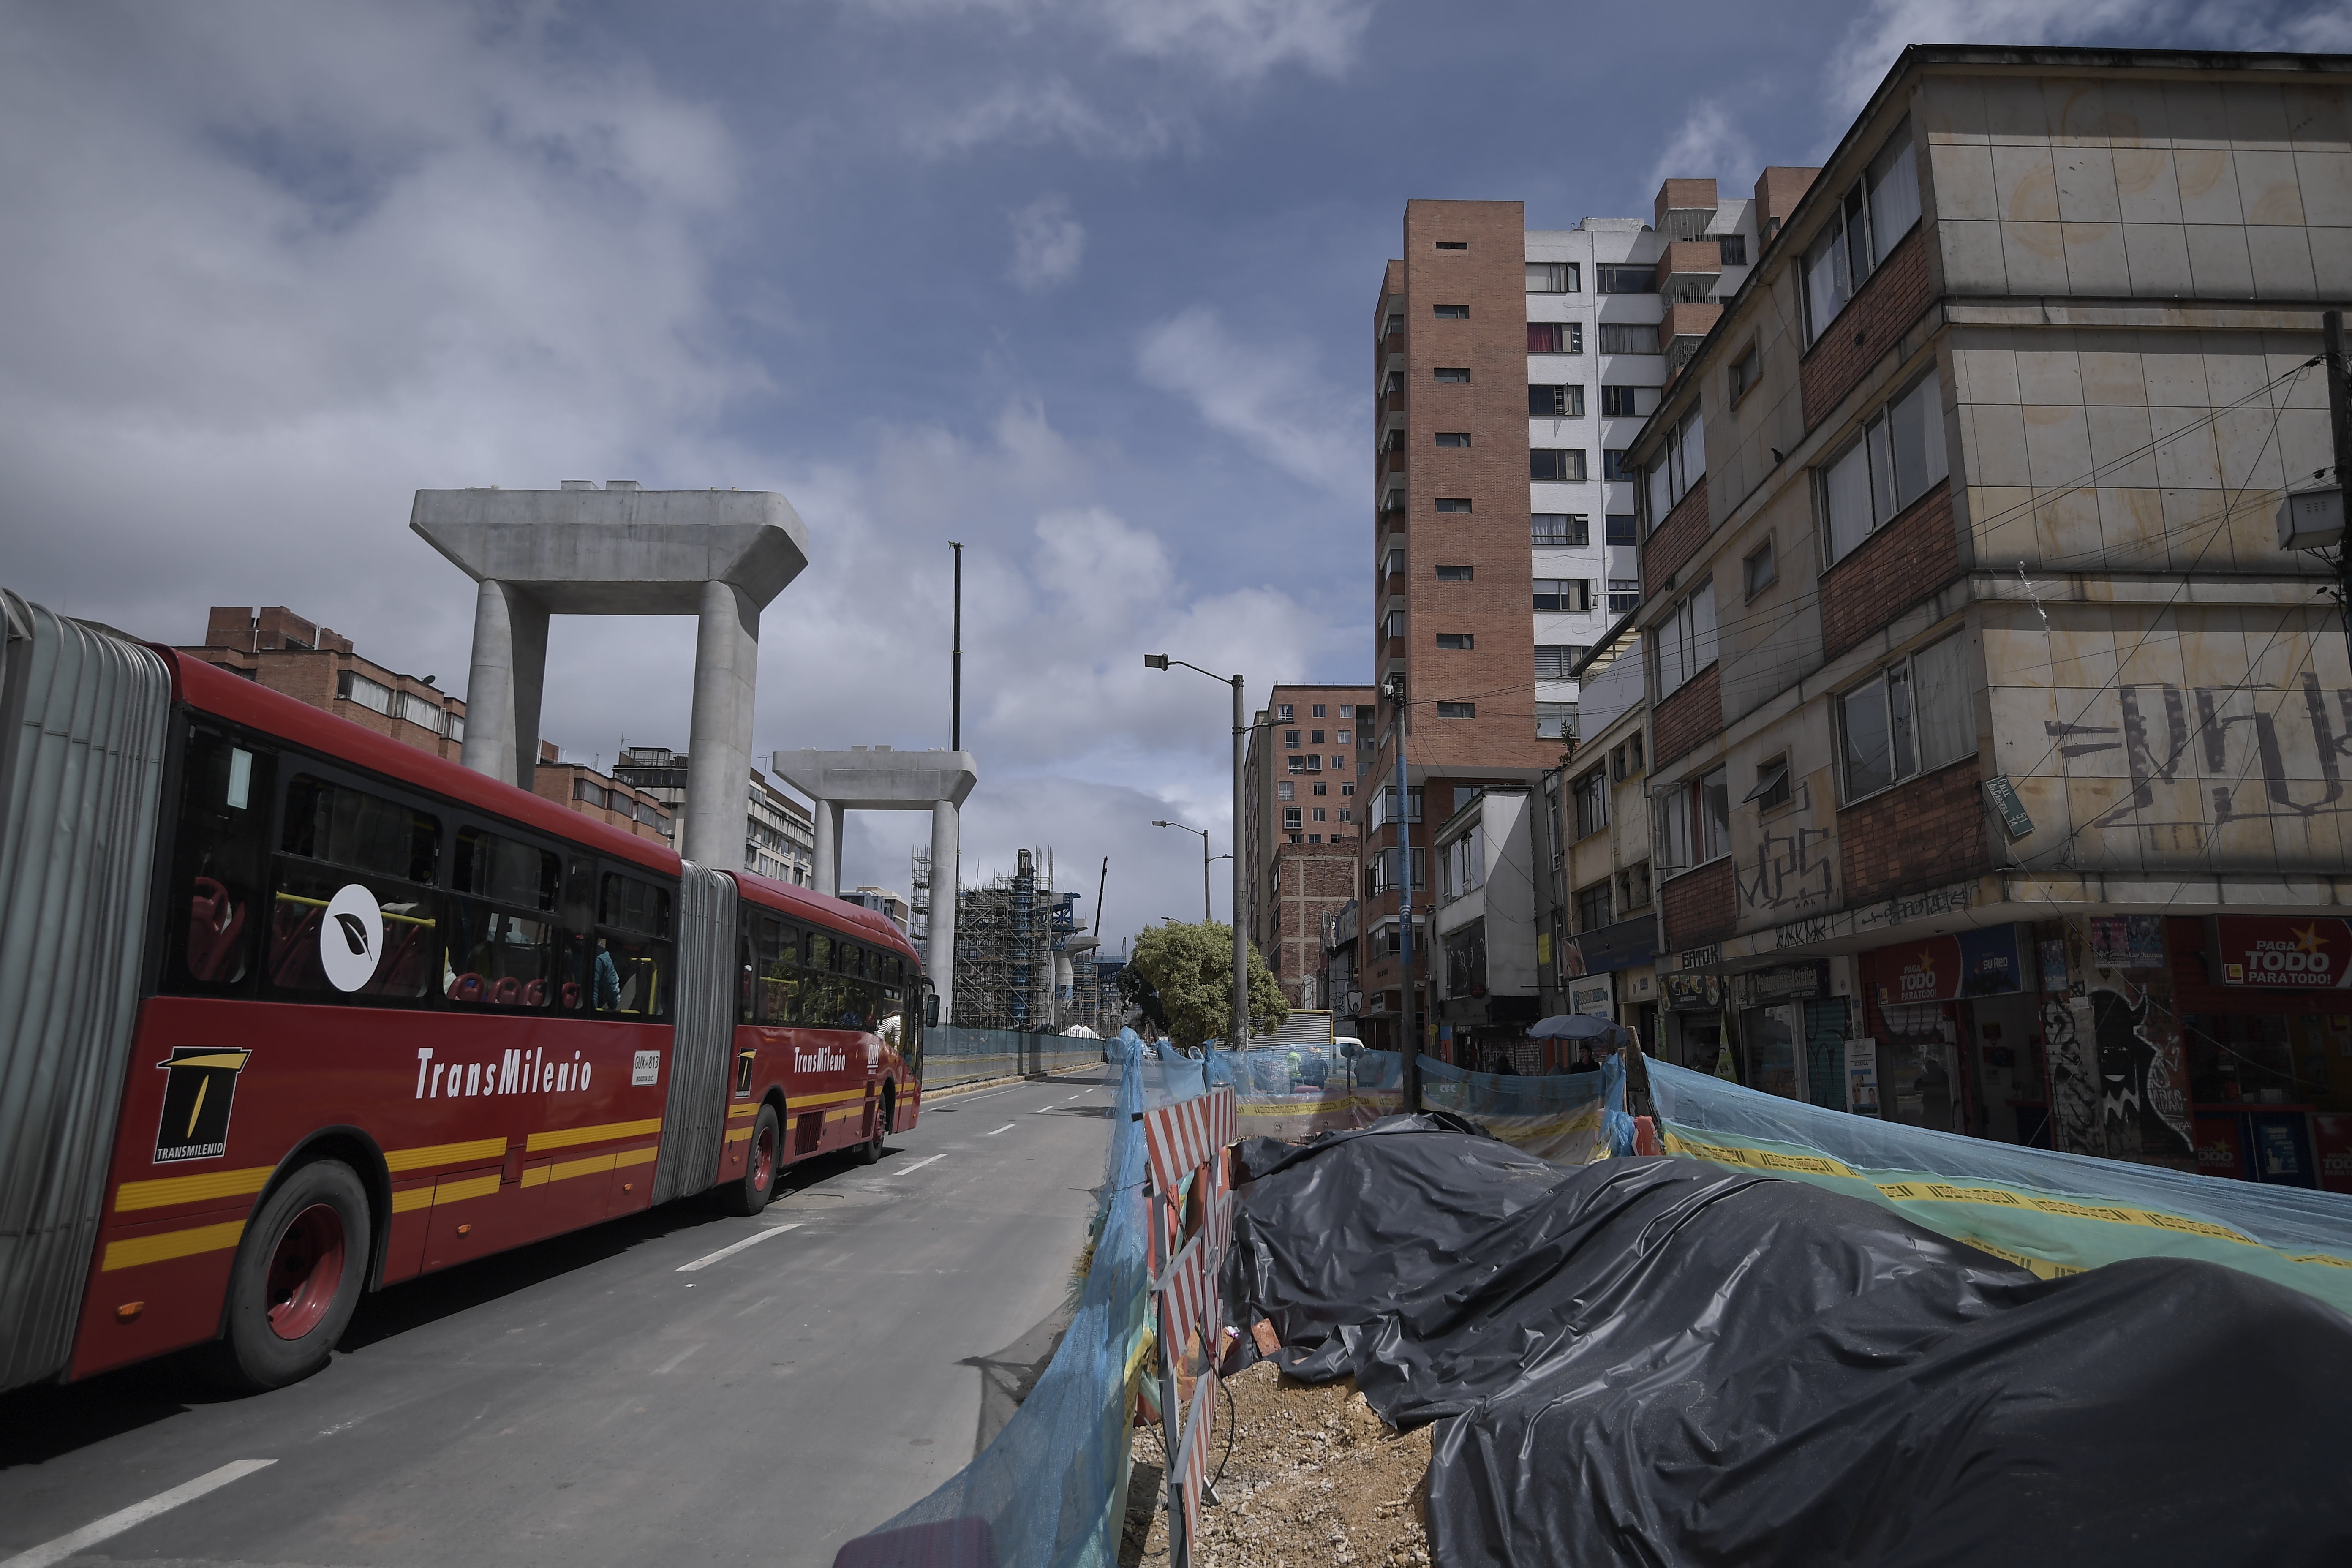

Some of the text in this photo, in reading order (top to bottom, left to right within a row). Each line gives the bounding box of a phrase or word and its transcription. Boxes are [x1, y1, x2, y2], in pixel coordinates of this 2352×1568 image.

[1997, 779, 2028, 824] CALLE 51
[2009, 817, 2018, 827] 14
[2257, 940, 2296, 951] PAGA
[1904, 964, 1921, 974] PAGA
[2245, 950, 2330, 972] TODO
[1900, 971, 1936, 991] TODO
[635, 1056, 659, 1069] GUX 813
[794, 1045, 846, 1073] TransMilenio
[416, 1047, 591, 1099] TransMilenio
[157, 1142, 223, 1160] TRANSMILENIO
[2198, 1152, 2233, 1162] ODO
